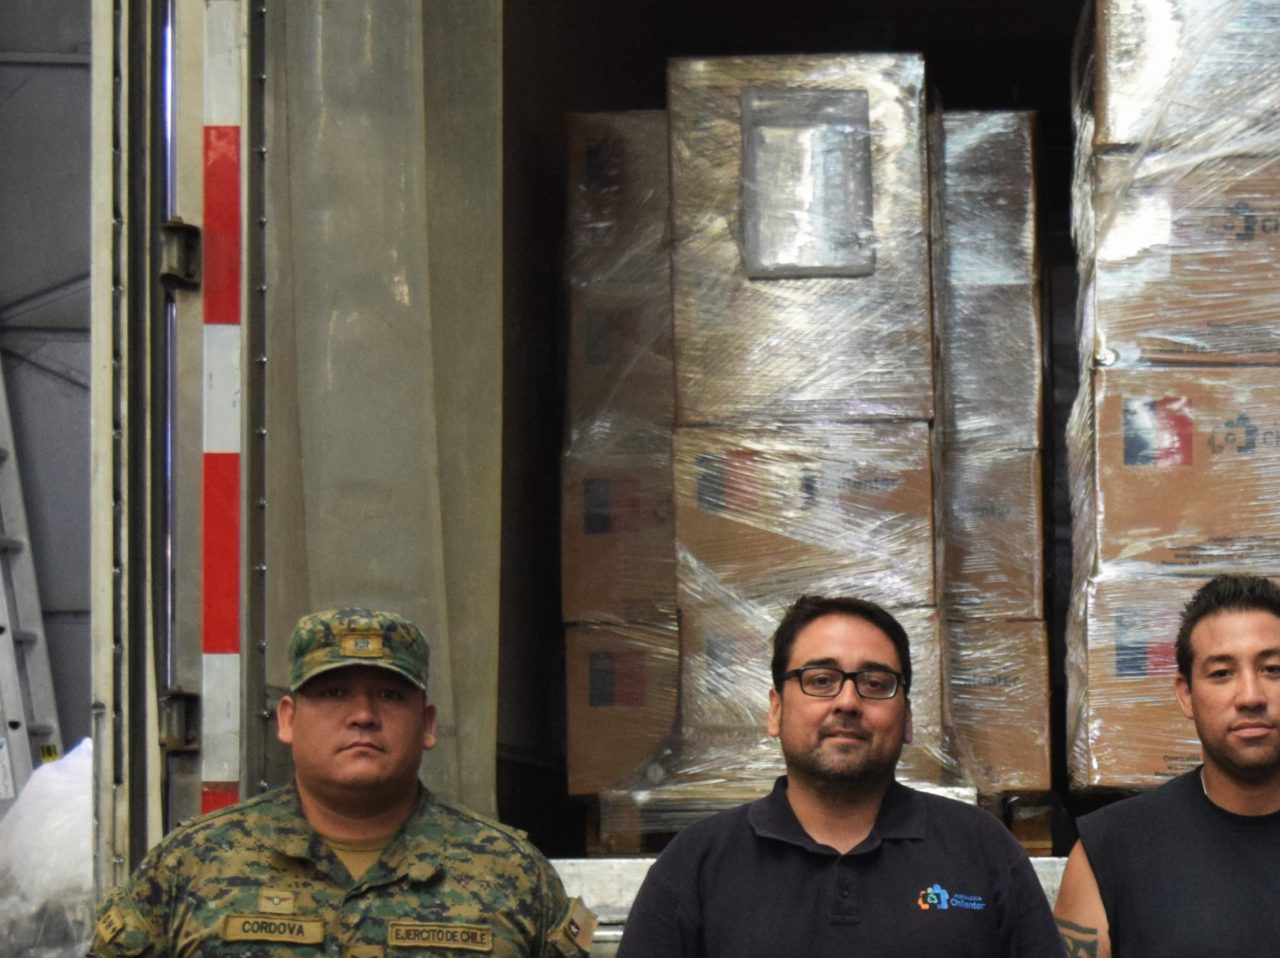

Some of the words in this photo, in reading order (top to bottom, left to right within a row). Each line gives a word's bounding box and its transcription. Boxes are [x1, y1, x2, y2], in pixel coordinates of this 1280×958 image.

[241, 920, 305, 937] CORDOVA
[394, 927, 444, 943] EJERCITO
[445, 930, 460, 943] DE
[460, 930, 488, 945] CHILE
